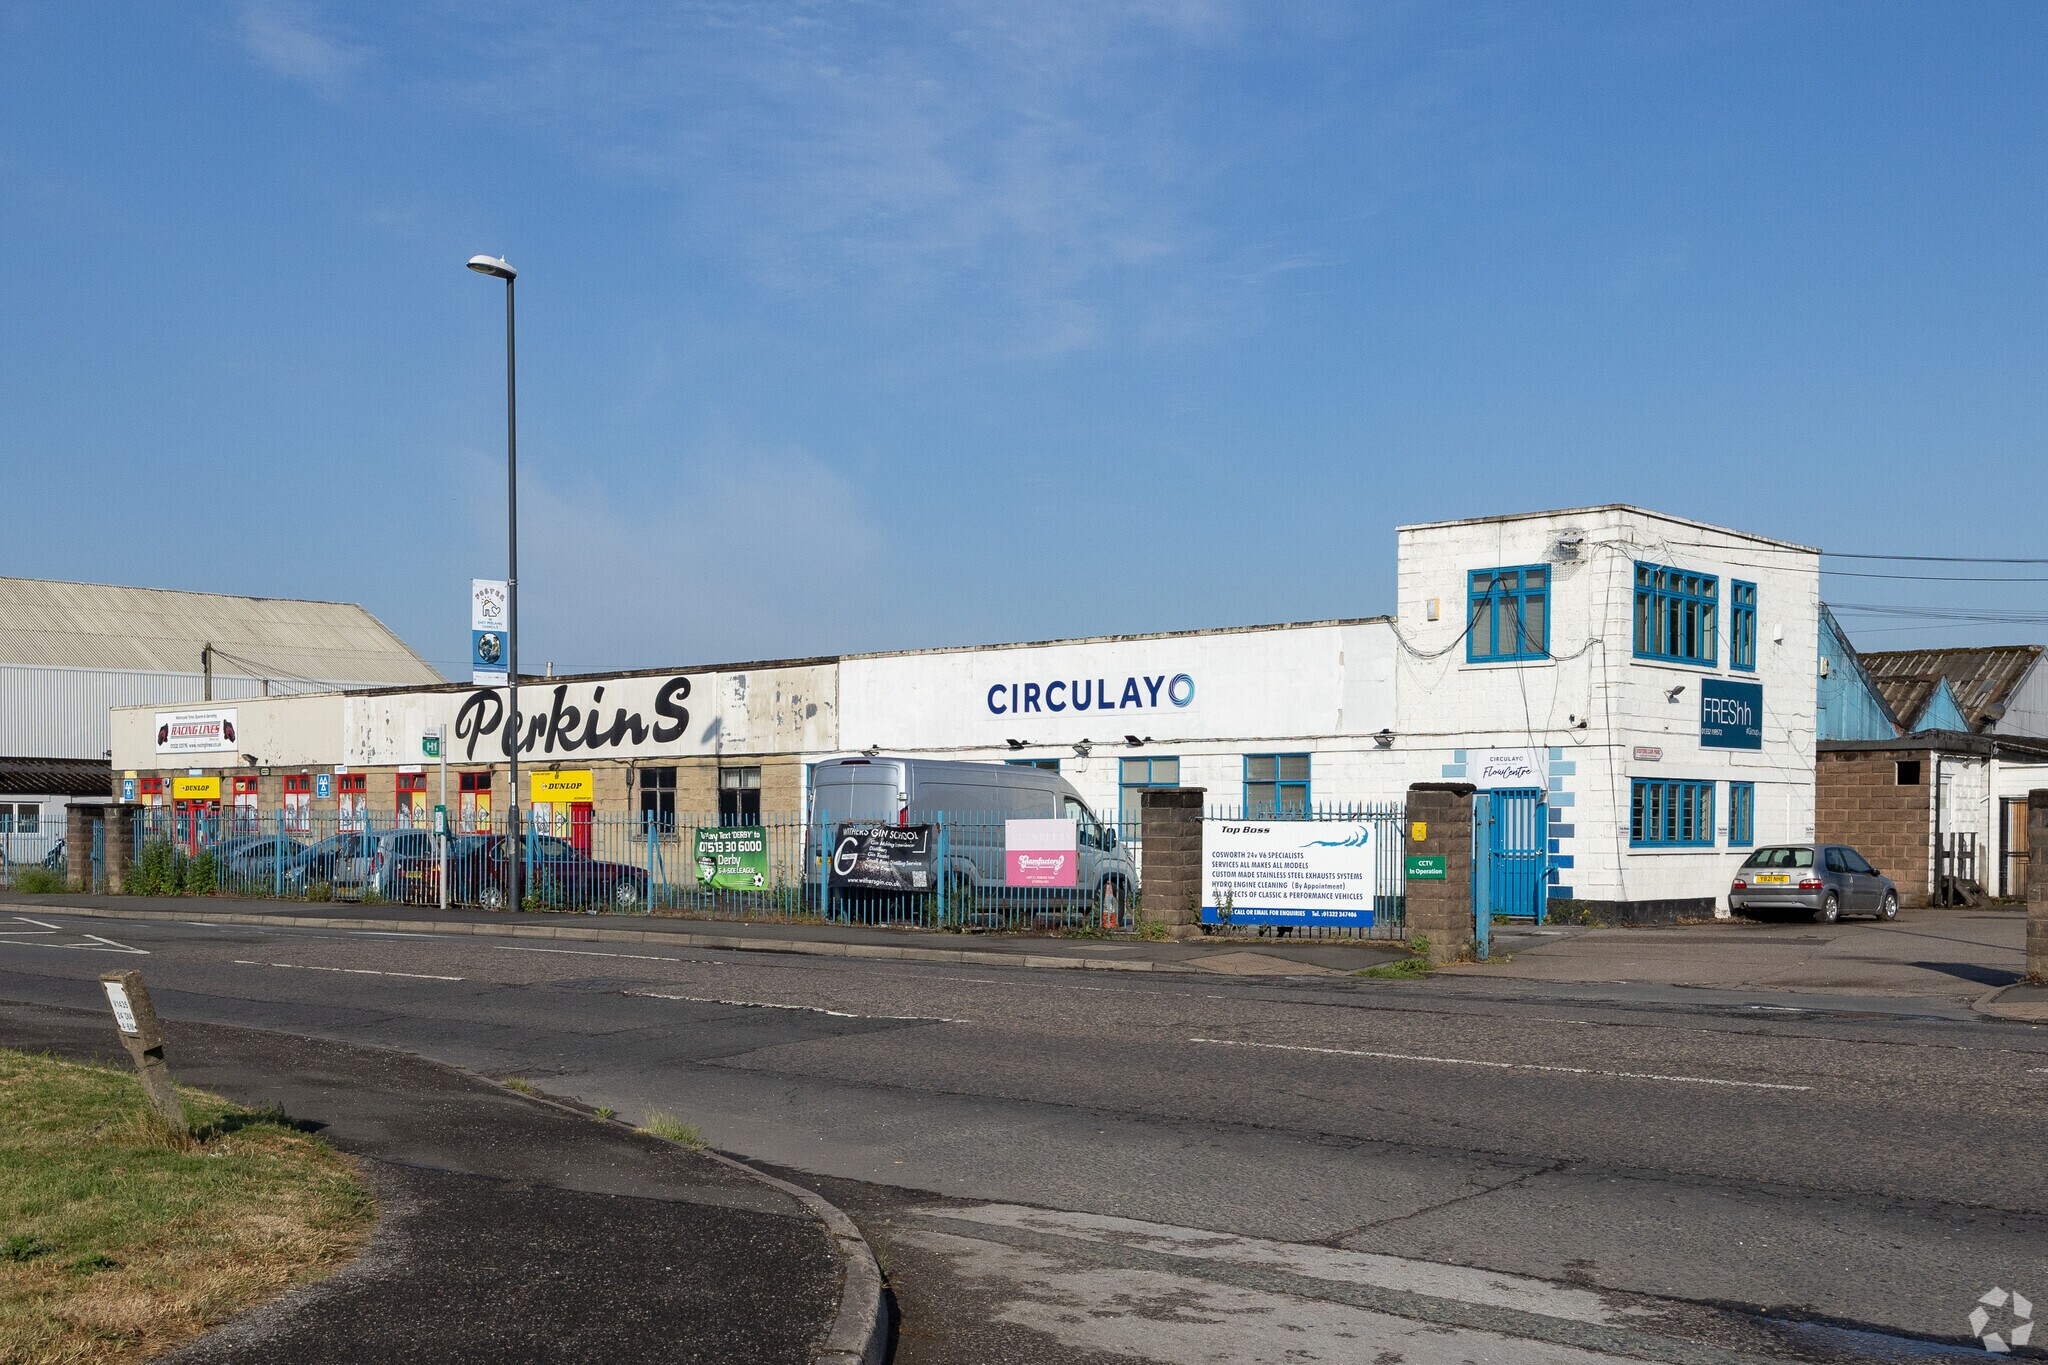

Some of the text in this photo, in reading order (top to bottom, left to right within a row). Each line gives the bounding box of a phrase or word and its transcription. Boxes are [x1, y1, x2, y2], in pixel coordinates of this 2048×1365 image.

[475, 588, 505, 601] FOSTER
[1703, 697, 1751, 726] FREShh
[171, 724, 220, 735] RACING LINES
[426, 742, 438, 751] H1
[871, 828, 888, 838] GIN
[890, 830, 918, 840] SCHOOL
[1222, 826, 1240, 834] Top
[725, 841, 736, 852] 30
[738, 840, 762, 852] 6000
[718, 854, 741, 867] Derby
[1291, 881, 1302, 890] (By
[1304, 882, 1346, 890] Appointment)
